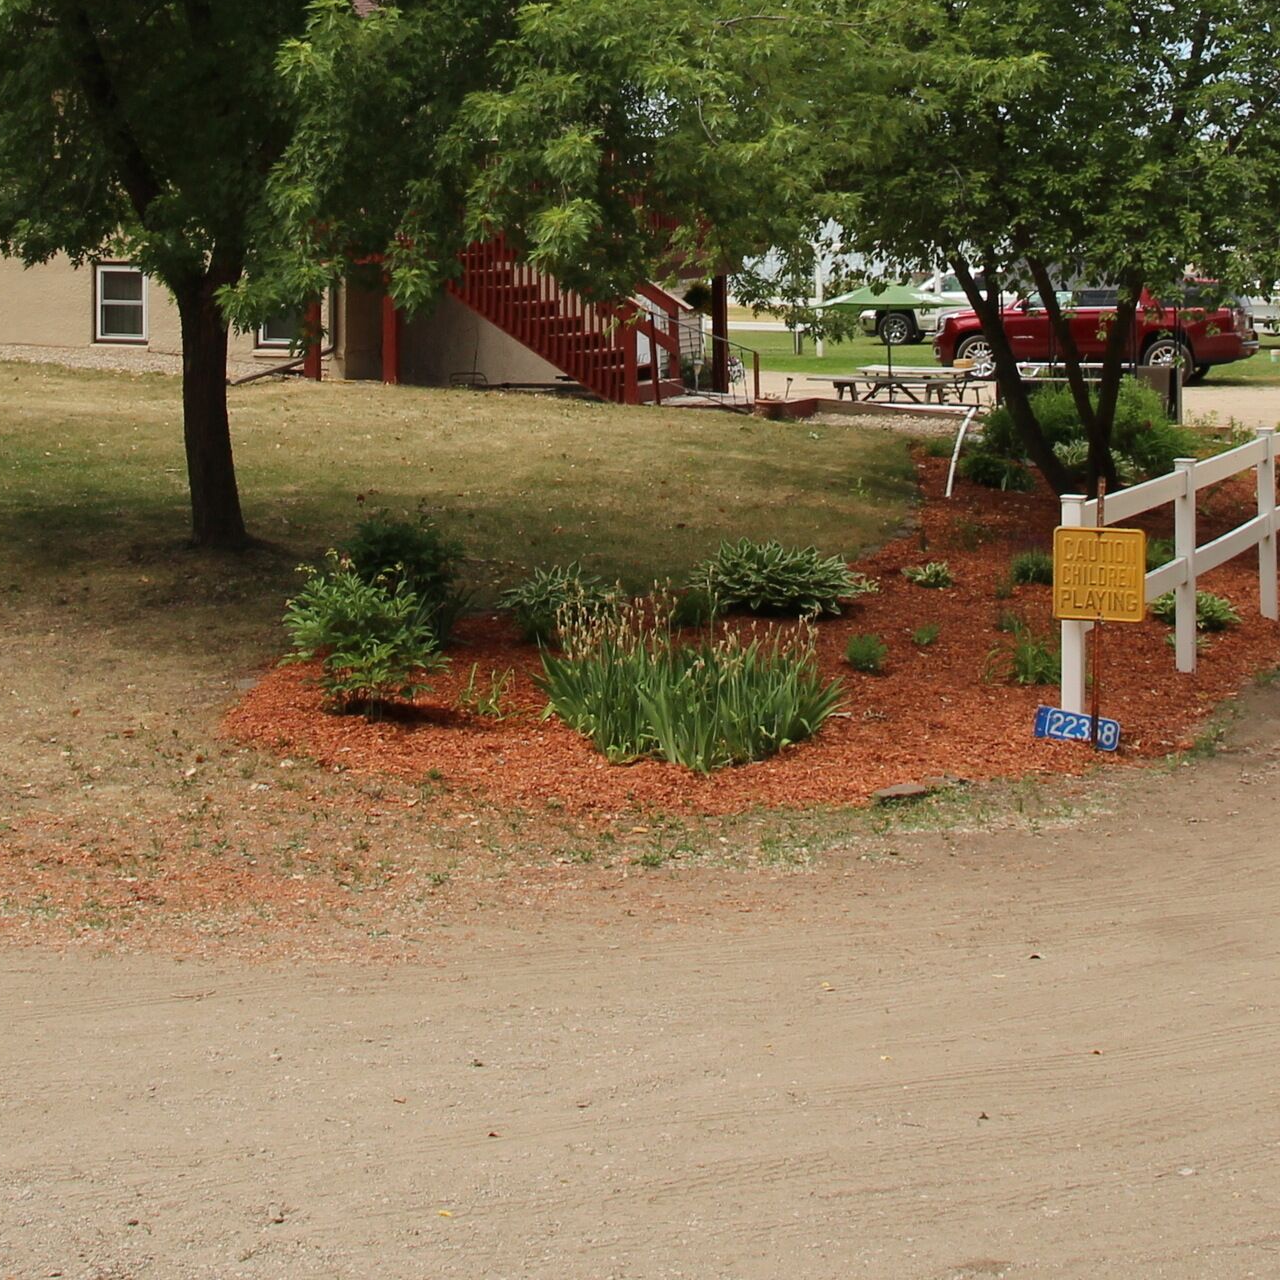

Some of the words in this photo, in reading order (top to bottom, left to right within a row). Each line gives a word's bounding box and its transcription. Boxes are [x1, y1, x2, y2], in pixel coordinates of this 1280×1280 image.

[1062, 537, 1136, 564] CAUTION
[1061, 564, 1137, 588] CHILDREN
[1060, 586, 1138, 612] PLAYING
